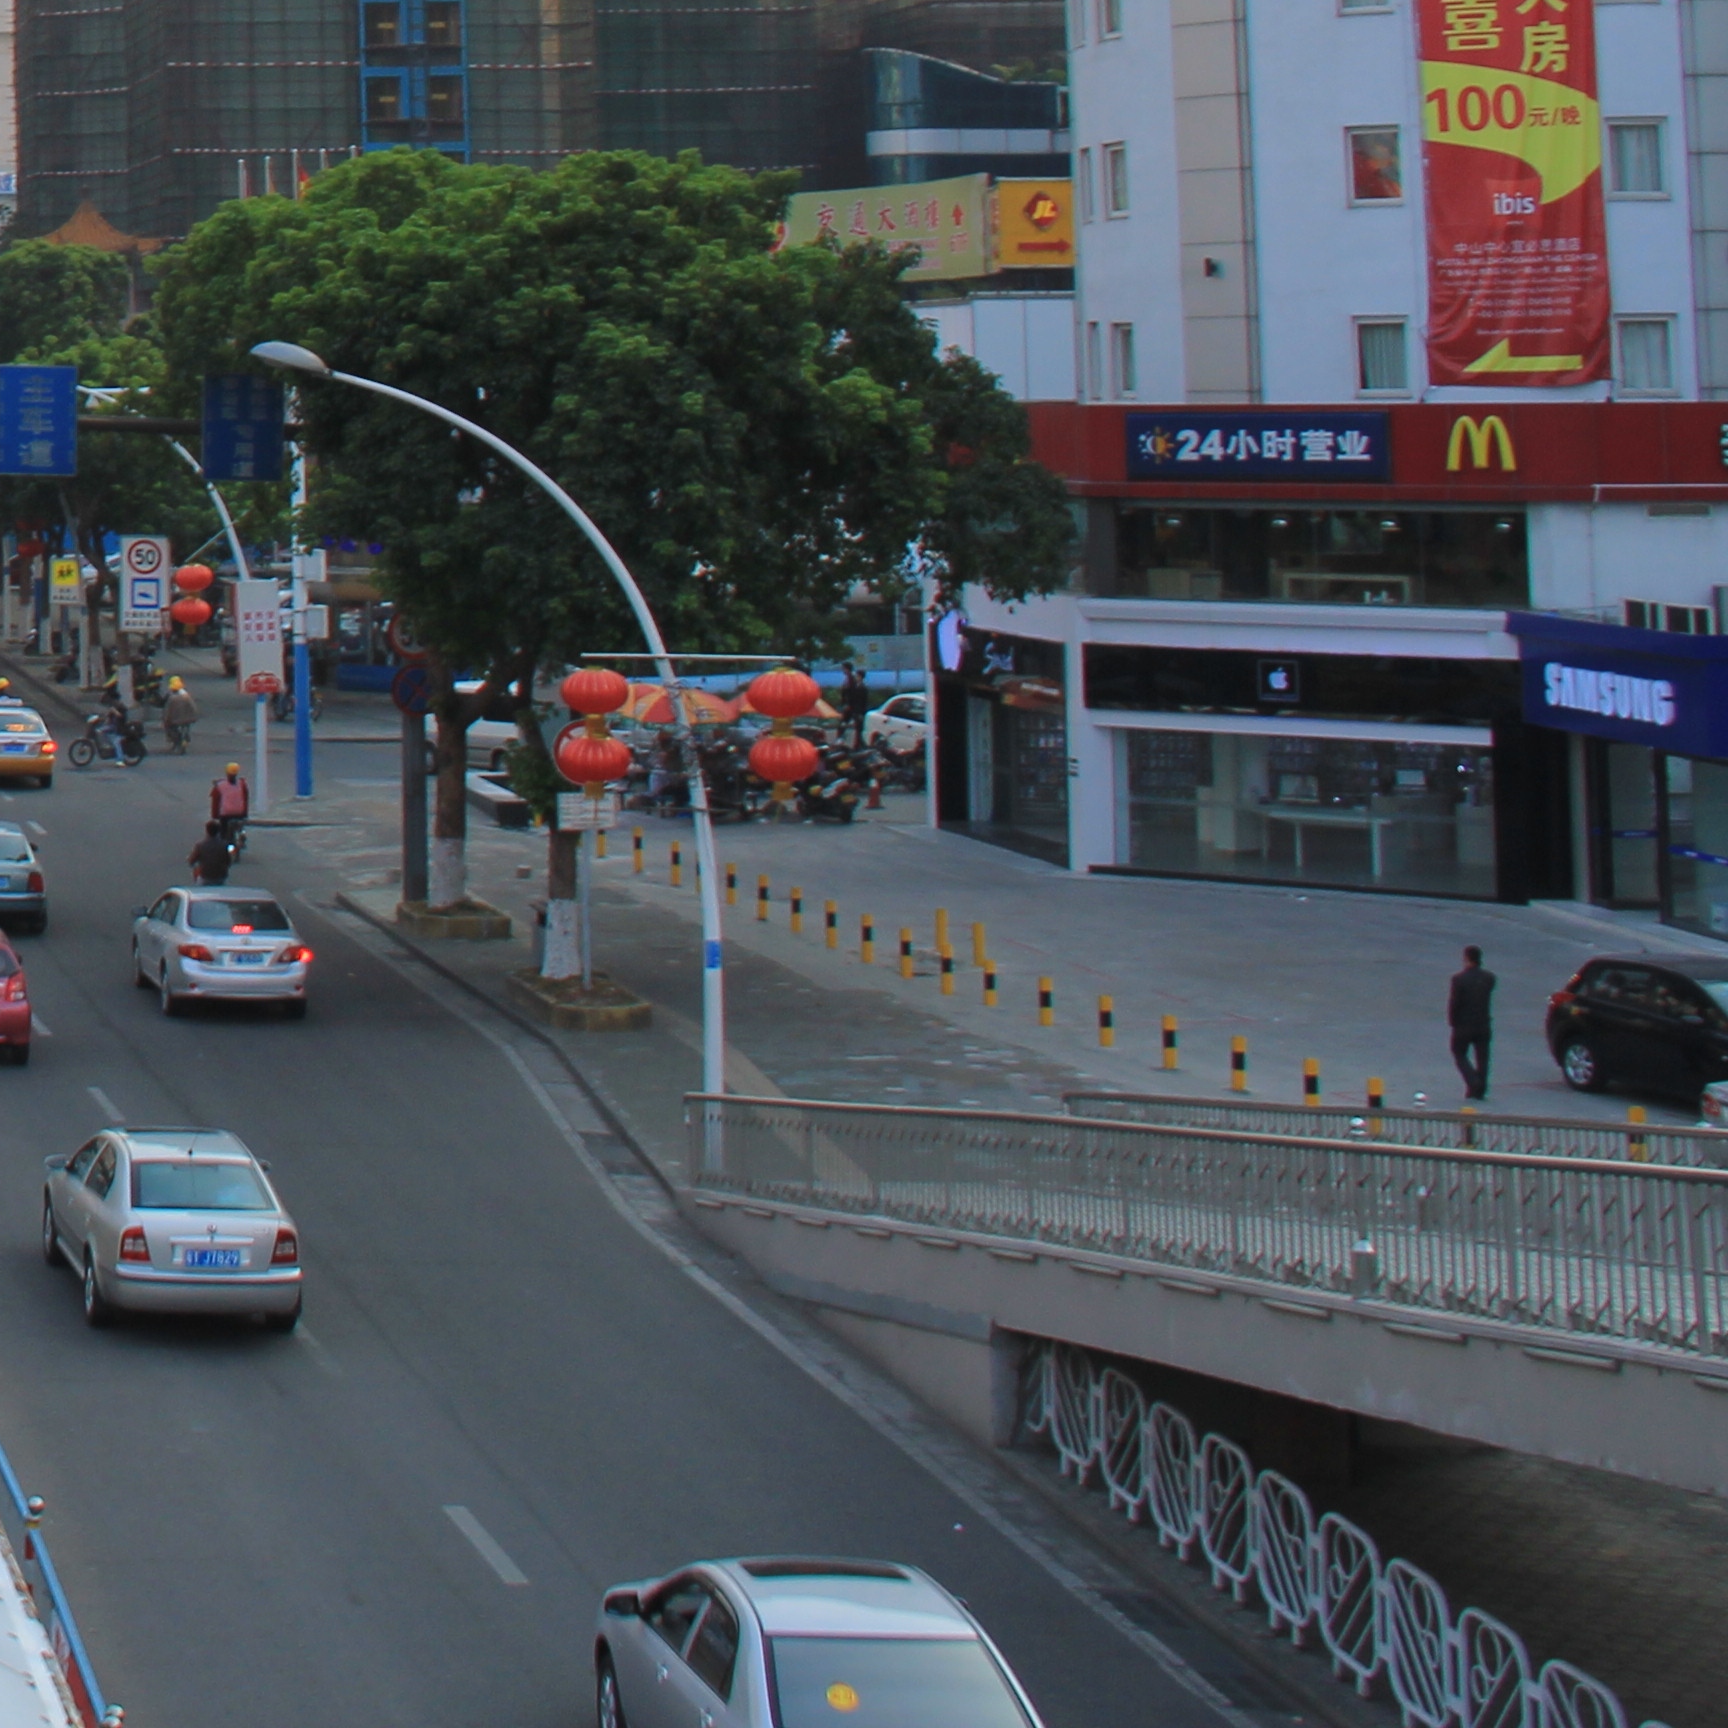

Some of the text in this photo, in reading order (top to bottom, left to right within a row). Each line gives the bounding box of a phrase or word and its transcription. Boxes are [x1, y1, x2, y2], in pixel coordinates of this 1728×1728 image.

[1493, 192, 1536, 215] ibis
[1175, 428, 1372, 462] 24小时营业
[136, 548, 155, 565] 50
[1544, 661, 1676, 726] SAMSUNG
